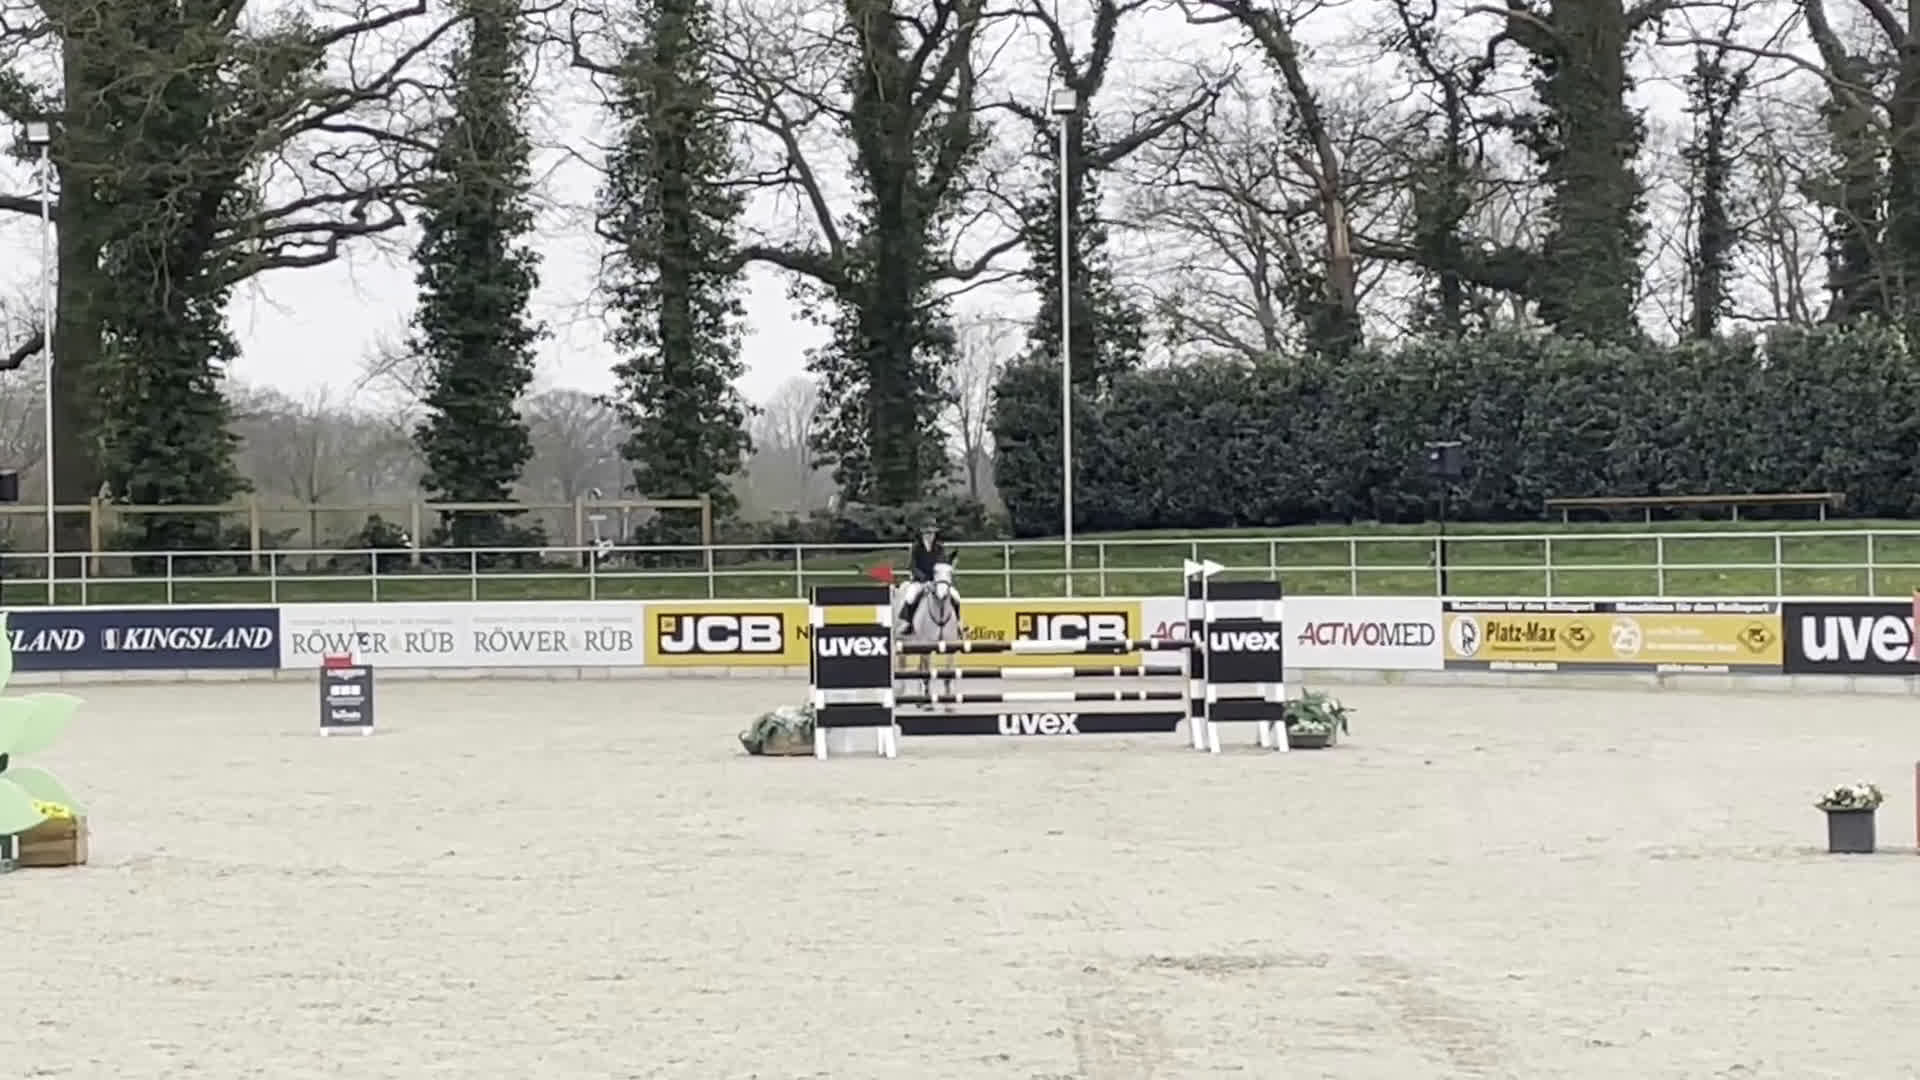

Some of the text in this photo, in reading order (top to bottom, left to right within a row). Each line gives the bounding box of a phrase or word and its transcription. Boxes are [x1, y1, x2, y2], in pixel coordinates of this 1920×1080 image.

[8, 629, 85, 651] LAND
[122, 627, 273, 650] KINGSLAND
[405, 628, 454, 653] RÜB
[473, 627, 568, 652] RÖWER
[584, 626, 633, 651] RÜB
[661, 615, 782, 652] JCB
[1210, 631, 1280, 651] uvex
[1486, 622, 1556, 642] Platz-Max
[1802, 615, 1915, 662] uve
[818, 636, 889, 656] uvex
[998, 713, 1080, 735] uvex
